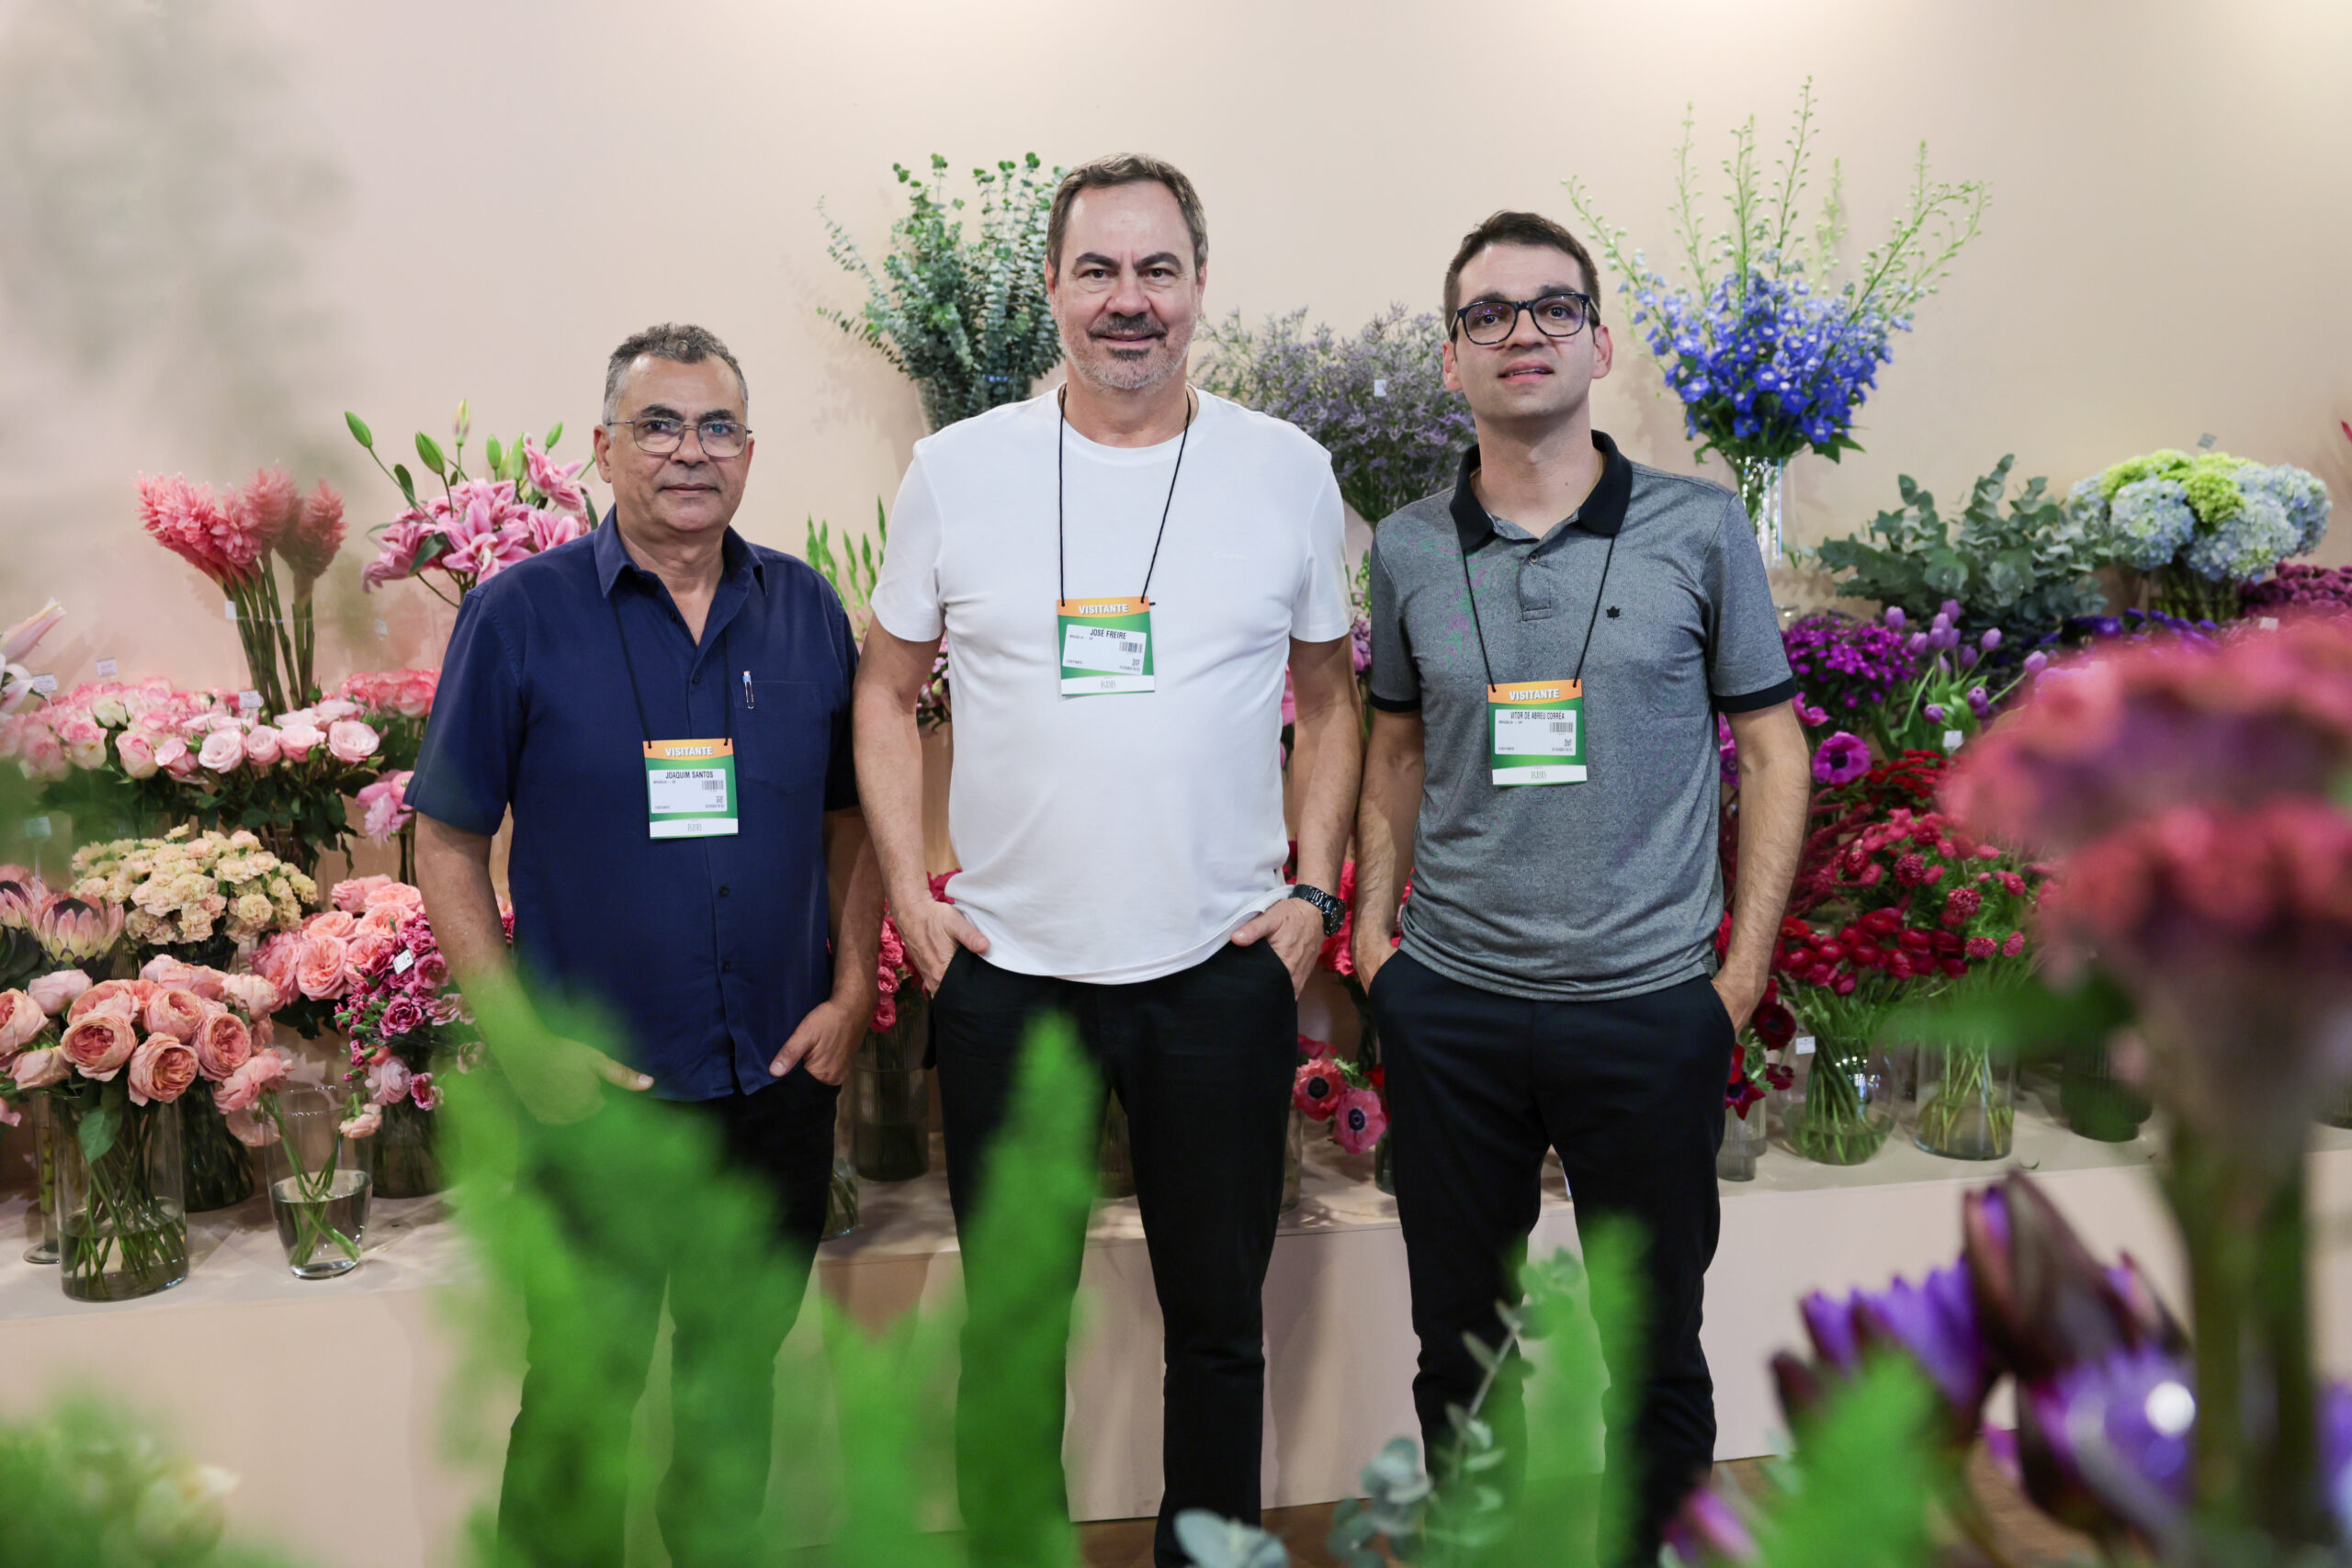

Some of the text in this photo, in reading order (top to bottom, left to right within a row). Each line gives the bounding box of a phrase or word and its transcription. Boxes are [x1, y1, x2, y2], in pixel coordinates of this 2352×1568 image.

[1079, 604, 1128, 615] VISITANTE
[1090, 628, 1104, 637] JOSE
[1106, 630, 1126, 639] FREIRE
[1509, 689, 1560, 701] VISITANTE
[1510, 711, 1523, 719] VITOR
[1524, 711, 1530, 719] DE
[1532, 712, 1545, 720] ABREU
[665, 746, 713, 757] VISITANTE
[665, 771, 714, 780] JOAQUIM SANTOS
